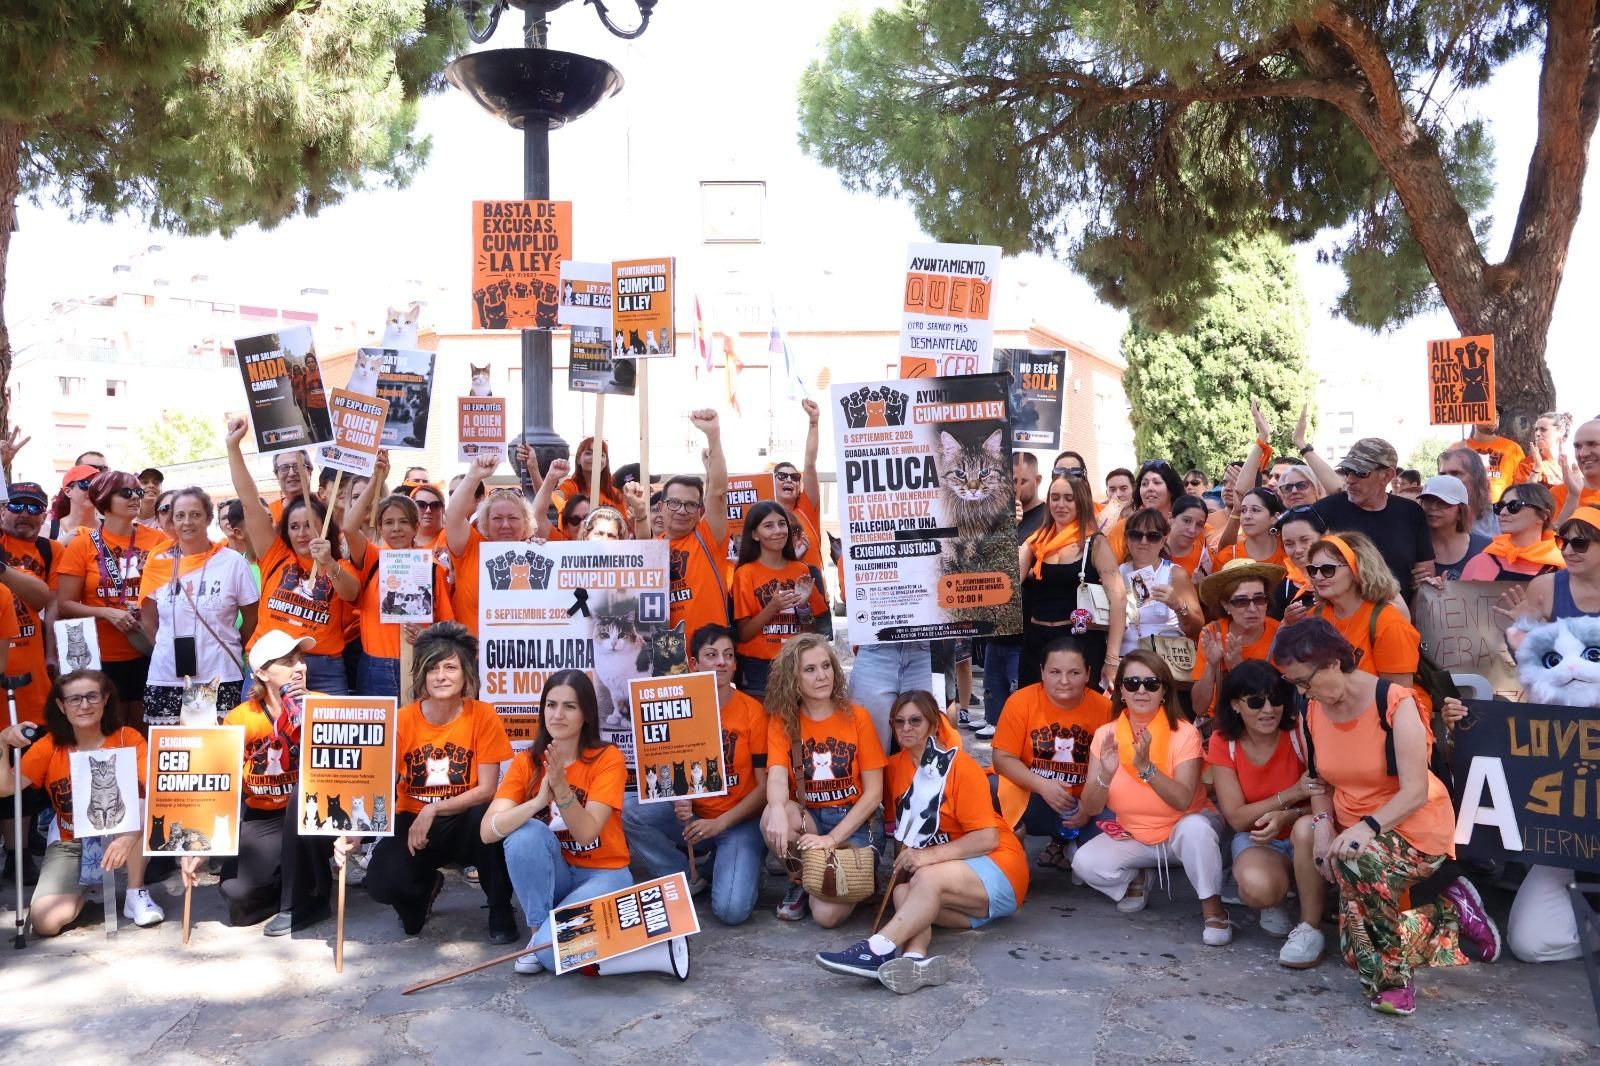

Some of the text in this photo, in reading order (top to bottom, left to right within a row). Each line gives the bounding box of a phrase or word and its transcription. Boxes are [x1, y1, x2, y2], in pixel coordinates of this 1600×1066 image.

[483, 203, 556, 217] BASTA DE
[483, 219, 557, 234] EXCUSAS.
[482, 234, 559, 252] CUMPLID
[490, 252, 554, 272] LA LEY
[618, 264, 666, 277] AYUNTAMIENTOS
[910, 257, 985, 276] AYUNTAMIENTO
[587, 284, 598, 293] LEY
[618, 276, 665, 294] CUMPLID
[575, 293, 591, 306] SIN
[618, 295, 651, 312] LA LEY
[906, 278, 985, 314] QUER
[910, 337, 978, 352] DESMANTELADO
[1432, 342, 1454, 363] ALL
[252, 353, 260, 361] NO
[247, 357, 288, 382] NADA
[1020, 362, 1059, 375] NO ESTÁS
[1433, 362, 1459, 384] CATS
[251, 379, 278, 392] CAMBIA
[1023, 373, 1057, 391] SOLA
[1434, 384, 1457, 404] ARE
[334, 396, 383, 417] NO EXPLOTÉIS
[463, 403, 471, 411] NO
[915, 402, 1003, 423] CUMPLID LA LEY
[1434, 402, 1491, 423] BEAUTIFUL
[343, 413, 379, 435] QUIEN
[463, 414, 502, 427] A QUIEN
[345, 429, 376, 448] CUIDA
[463, 427, 502, 438] ME CUIDA
[844, 430, 913, 443] 6 SEPTIEMBRE 2026
[845, 449, 890, 459] GUADALAJARA
[891, 448, 900, 456] SE
[845, 455, 940, 494] PILUCA
[847, 490, 940, 505] GATA CIEGA Y VULNERABLE
[848, 501, 930, 522] DE VALDELUZ
[849, 517, 937, 534] FALLECIDA POR UNA
[850, 532, 893, 544] NEGLIGENCIA
[854, 541, 936, 559] EXIGIMOS JUSTICIA
[561, 555, 644, 568] AYUNTAMIENTOS
[854, 562, 898, 571] FALLECIMIENTO
[559, 572, 616, 588] CUMPLID
[620, 572, 635, 587] LA
[639, 571, 662, 588] LEY
[677, 588, 691, 601] LEY
[957, 594, 983, 603] 12:00 H
[267, 598, 302, 617] CUMPLID
[302, 608, 315, 621] LA
[486, 609, 492, 620] 6
[494, 608, 547, 620] SEPTIEMBRE
[645, 596, 661, 618] H
[486, 638, 595, 669] GUADALAJARA
[486, 671, 510, 695] SE
[639, 685, 684, 700] LOS GATOS
[312, 707, 386, 721] AYUNTAMIENTOS
[495, 705, 539, 714] CONCENTRACIÓN
[640, 698, 692, 722] TIENEN
[312, 723, 384, 746] CUMPLID
[525, 728, 530, 737] H
[643, 723, 668, 744] LEY
[159, 751, 189, 771] CER
[311, 748, 361, 769] LA LEY
[157, 774, 230, 791] COMPLETO
[1066, 773, 1078, 784] LA
[831, 790, 843, 801] LA
[616, 893, 641, 928] TODOS
[640, 886, 669, 934] ES PARA
